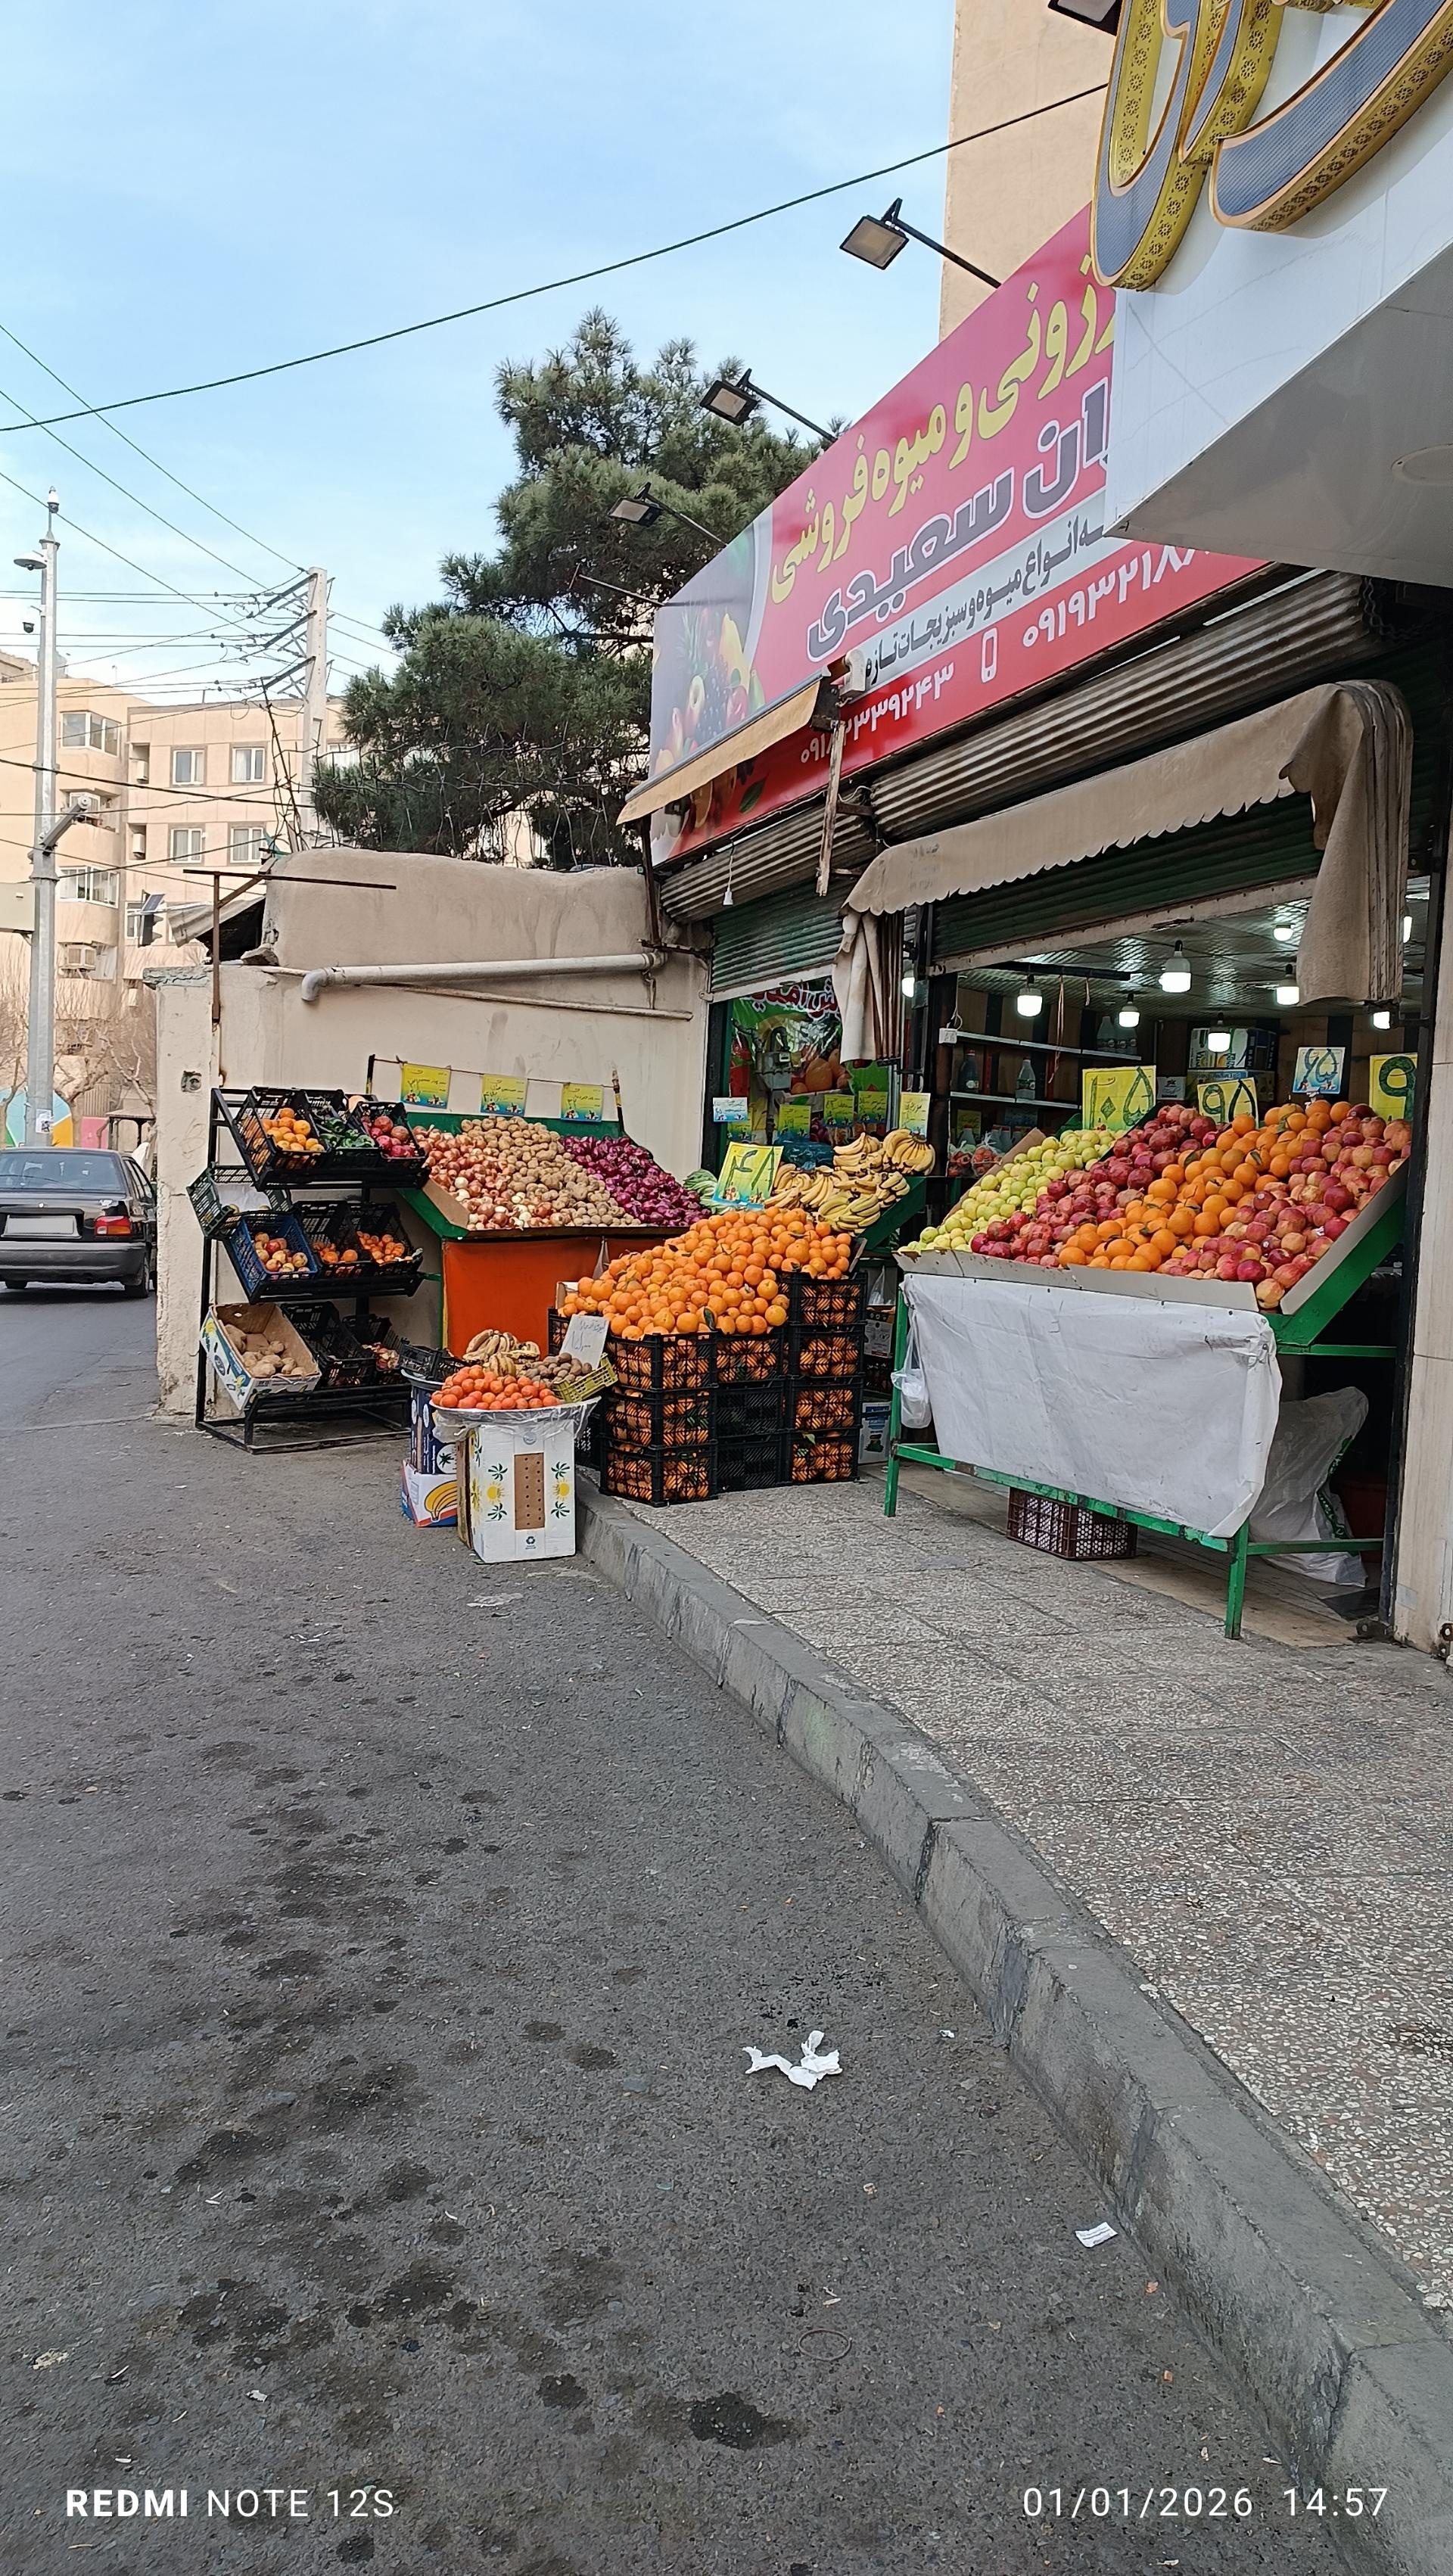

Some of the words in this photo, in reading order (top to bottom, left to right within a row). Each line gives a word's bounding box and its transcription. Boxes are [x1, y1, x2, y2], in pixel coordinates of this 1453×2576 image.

[871, 403, 947, 518] میوه
[947, 381, 973, 471] و
[770, 434, 869, 605] فروشی
[1022, 514, 1078, 596] انواع
[807, 466, 1015, 662] سعیدی
[977, 568, 1022, 621] میوه
[897, 602, 967, 659] سبزیجات
[966, 596, 976, 630] و
[723, 1146, 775, 1199] ۴۸
